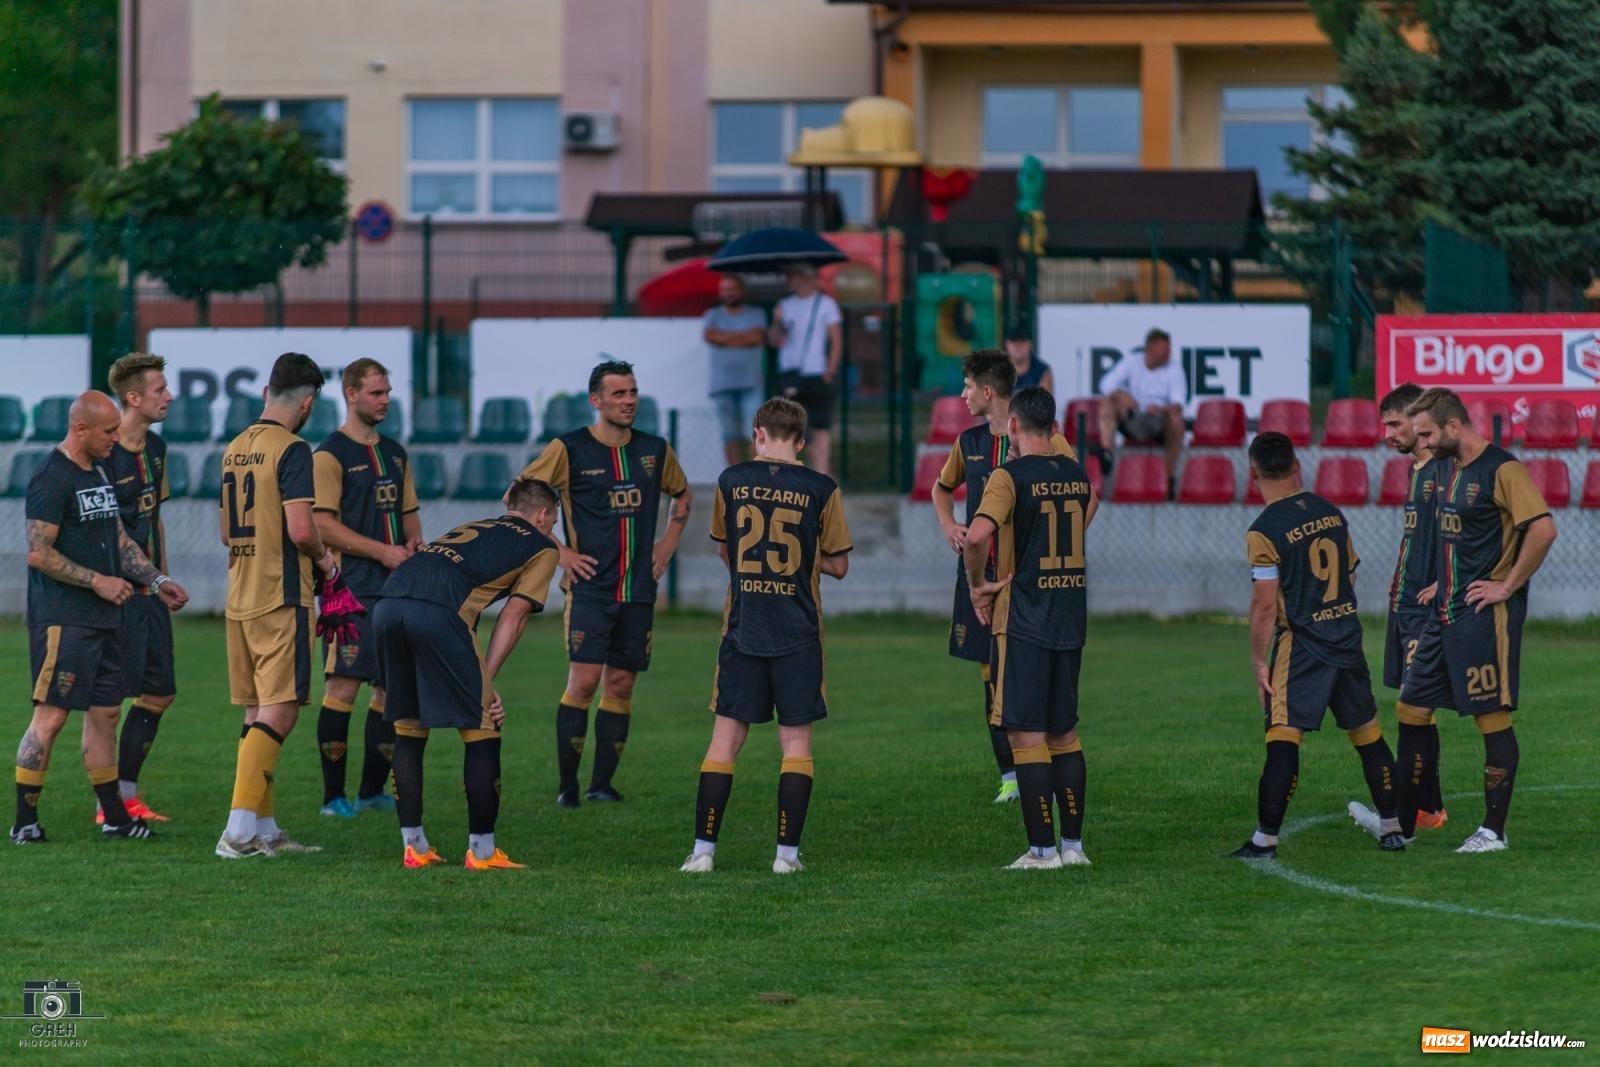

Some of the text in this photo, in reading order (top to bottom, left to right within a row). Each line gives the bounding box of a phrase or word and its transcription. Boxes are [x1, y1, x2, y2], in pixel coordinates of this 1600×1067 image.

[1414, 335, 1543, 384] Bingo
[223, 470, 256, 539] 12
[608, 488, 642, 509] 100
[732, 486, 810, 508] KS CZARNI
[1031, 482, 1049, 497] KS
[736, 504, 803, 577] 25
[1040, 499, 1085, 570] 11
[1285, 527, 1303, 544] KS
[1308, 537, 1340, 604] 9
[1466, 663, 1498, 695] 20
